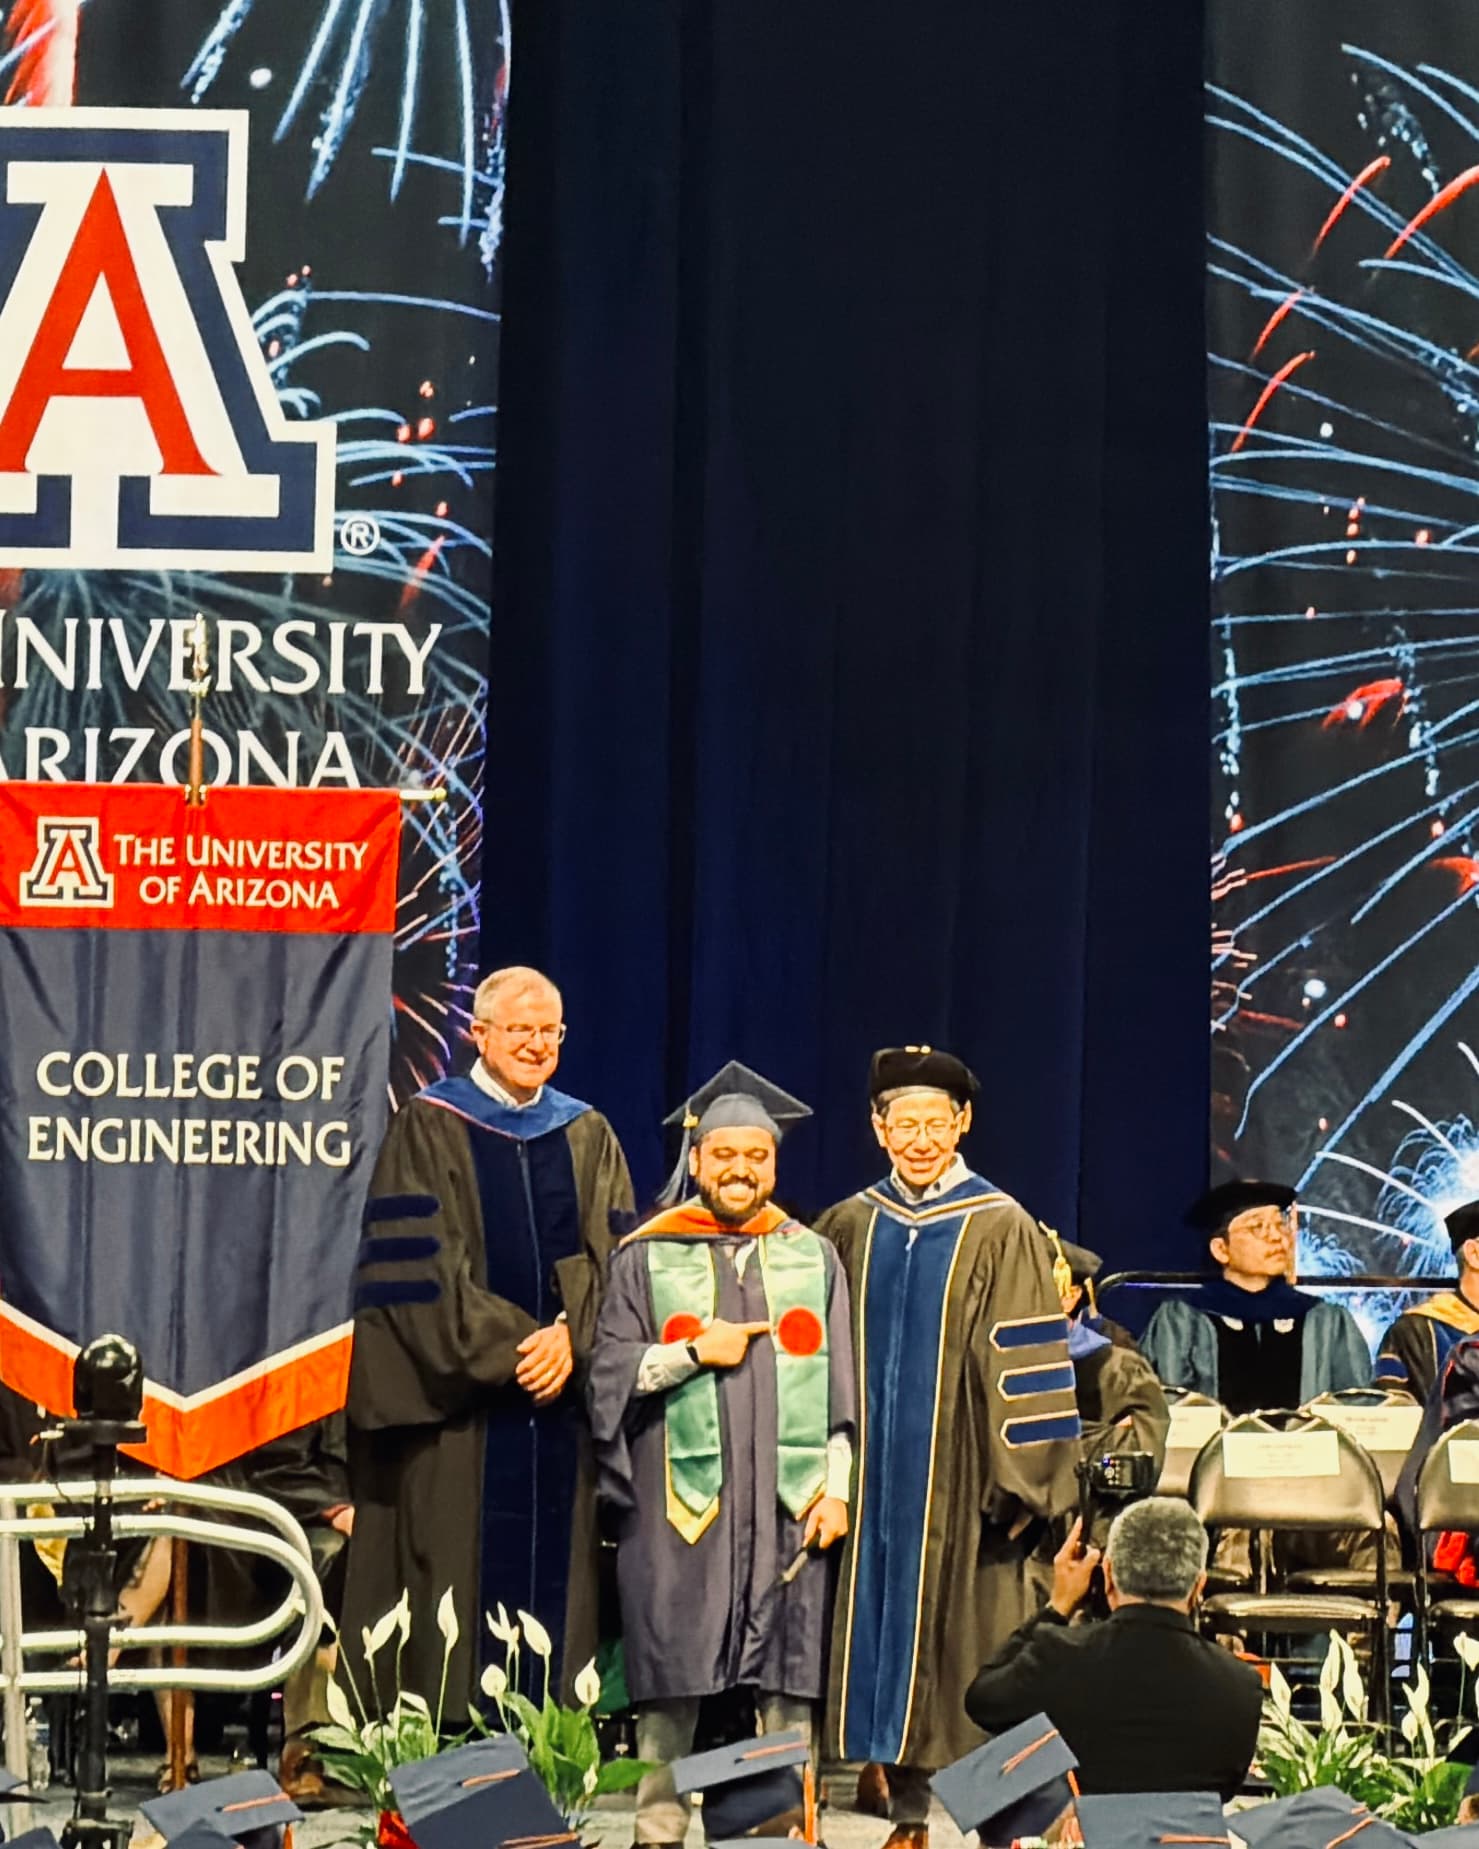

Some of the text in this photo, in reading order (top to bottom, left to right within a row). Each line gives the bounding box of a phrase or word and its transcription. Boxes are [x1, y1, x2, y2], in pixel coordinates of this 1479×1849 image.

[0, 106, 337, 573] A
[0, 609, 442, 695] NIVERSITY
[0, 727, 360, 787] RIZONA
[19, 816, 114, 909] A
[113, 834, 369, 871] THE UNIVERSITY
[139, 871, 340, 910] OF ARIZONA
[36, 1051, 345, 1100] COLLEGE OF
[28, 1116, 351, 1167] ENGINEERING
